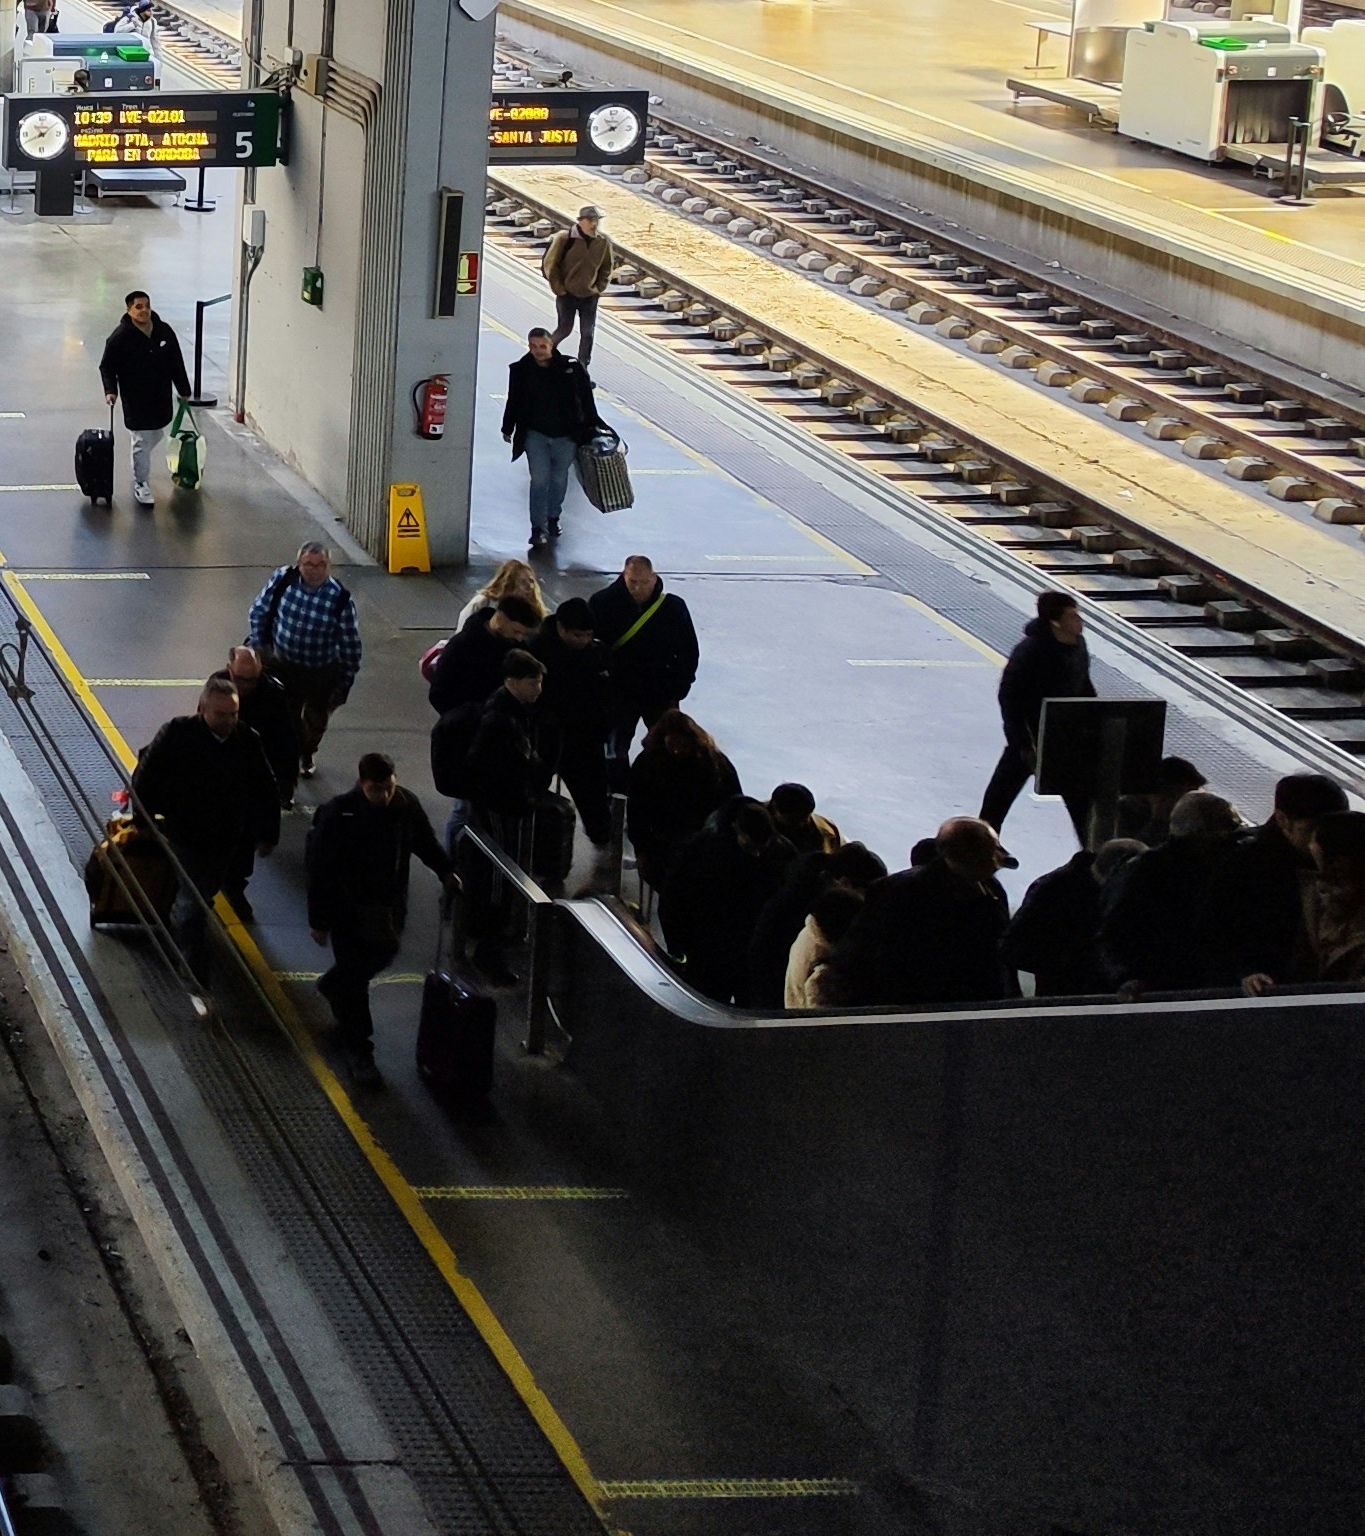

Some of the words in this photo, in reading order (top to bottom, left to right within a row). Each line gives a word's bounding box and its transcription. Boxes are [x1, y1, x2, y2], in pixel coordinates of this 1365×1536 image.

[73, 133, 120, 148] MADRID
[538, 129, 578, 144] JUSTA
[235, 130, 254, 159] 5
